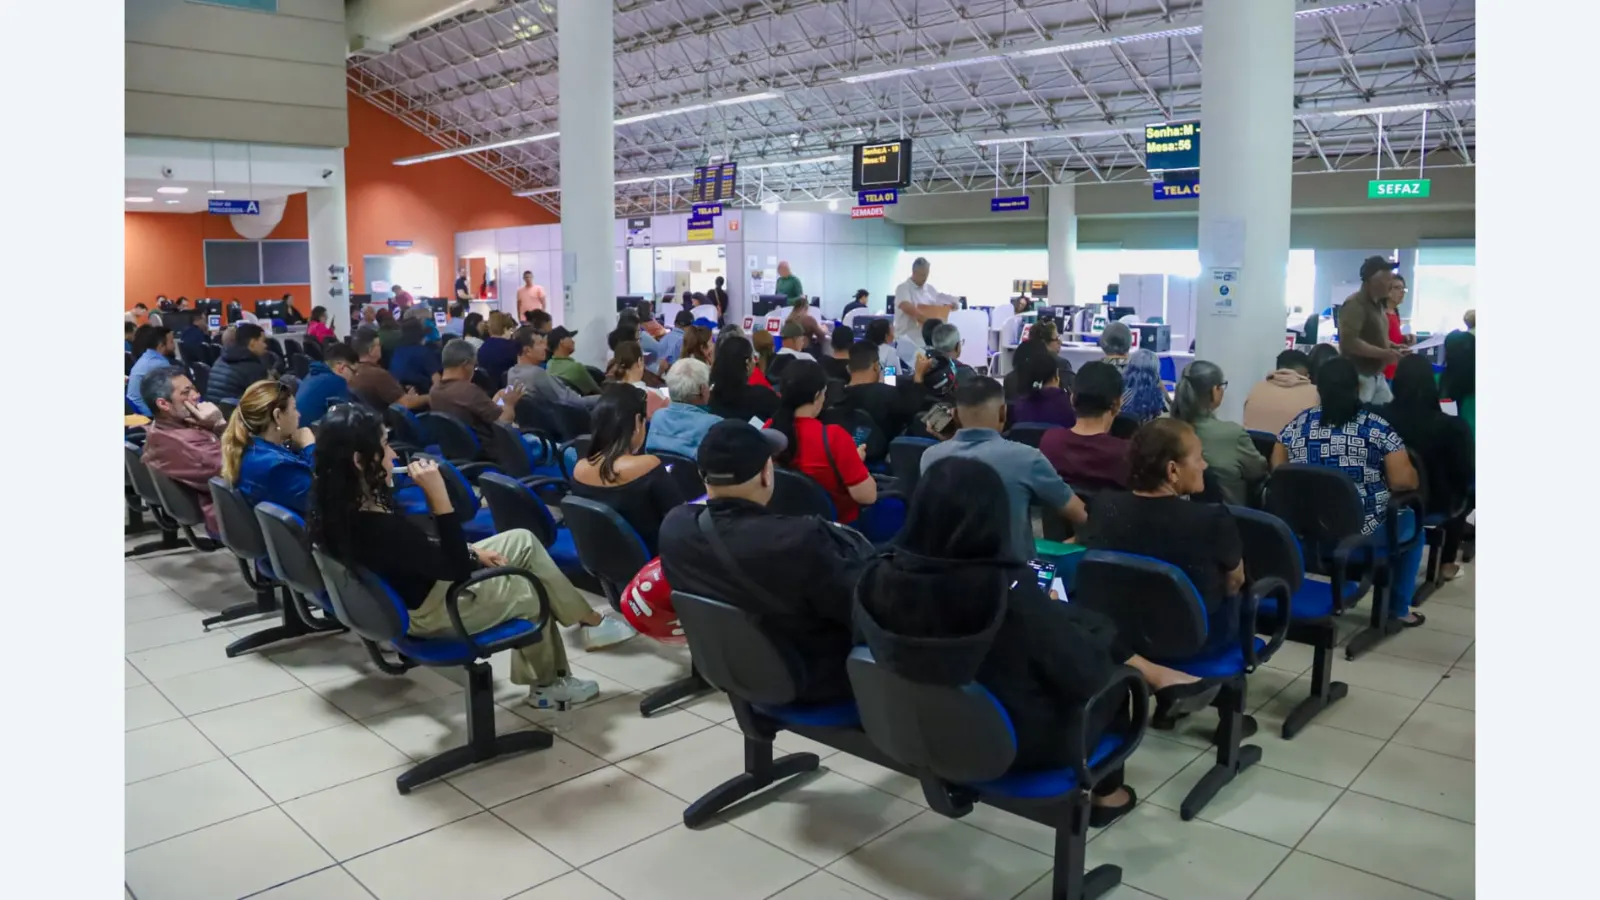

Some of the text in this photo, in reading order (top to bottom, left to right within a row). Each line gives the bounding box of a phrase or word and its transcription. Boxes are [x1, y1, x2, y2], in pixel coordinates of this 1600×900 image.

[1146, 124, 1193, 138] Senha:M
[1146, 139, 1192, 153] Mesa:56
[1163, 184, 1200, 196] TELA 0
[1377, 183, 1420, 195] SEFAZ
[865, 193, 894, 202] TELA 01
[246, 200, 258, 214] A
[697, 207, 712, 215] TELA
[852, 207, 883, 217] SEMADES
